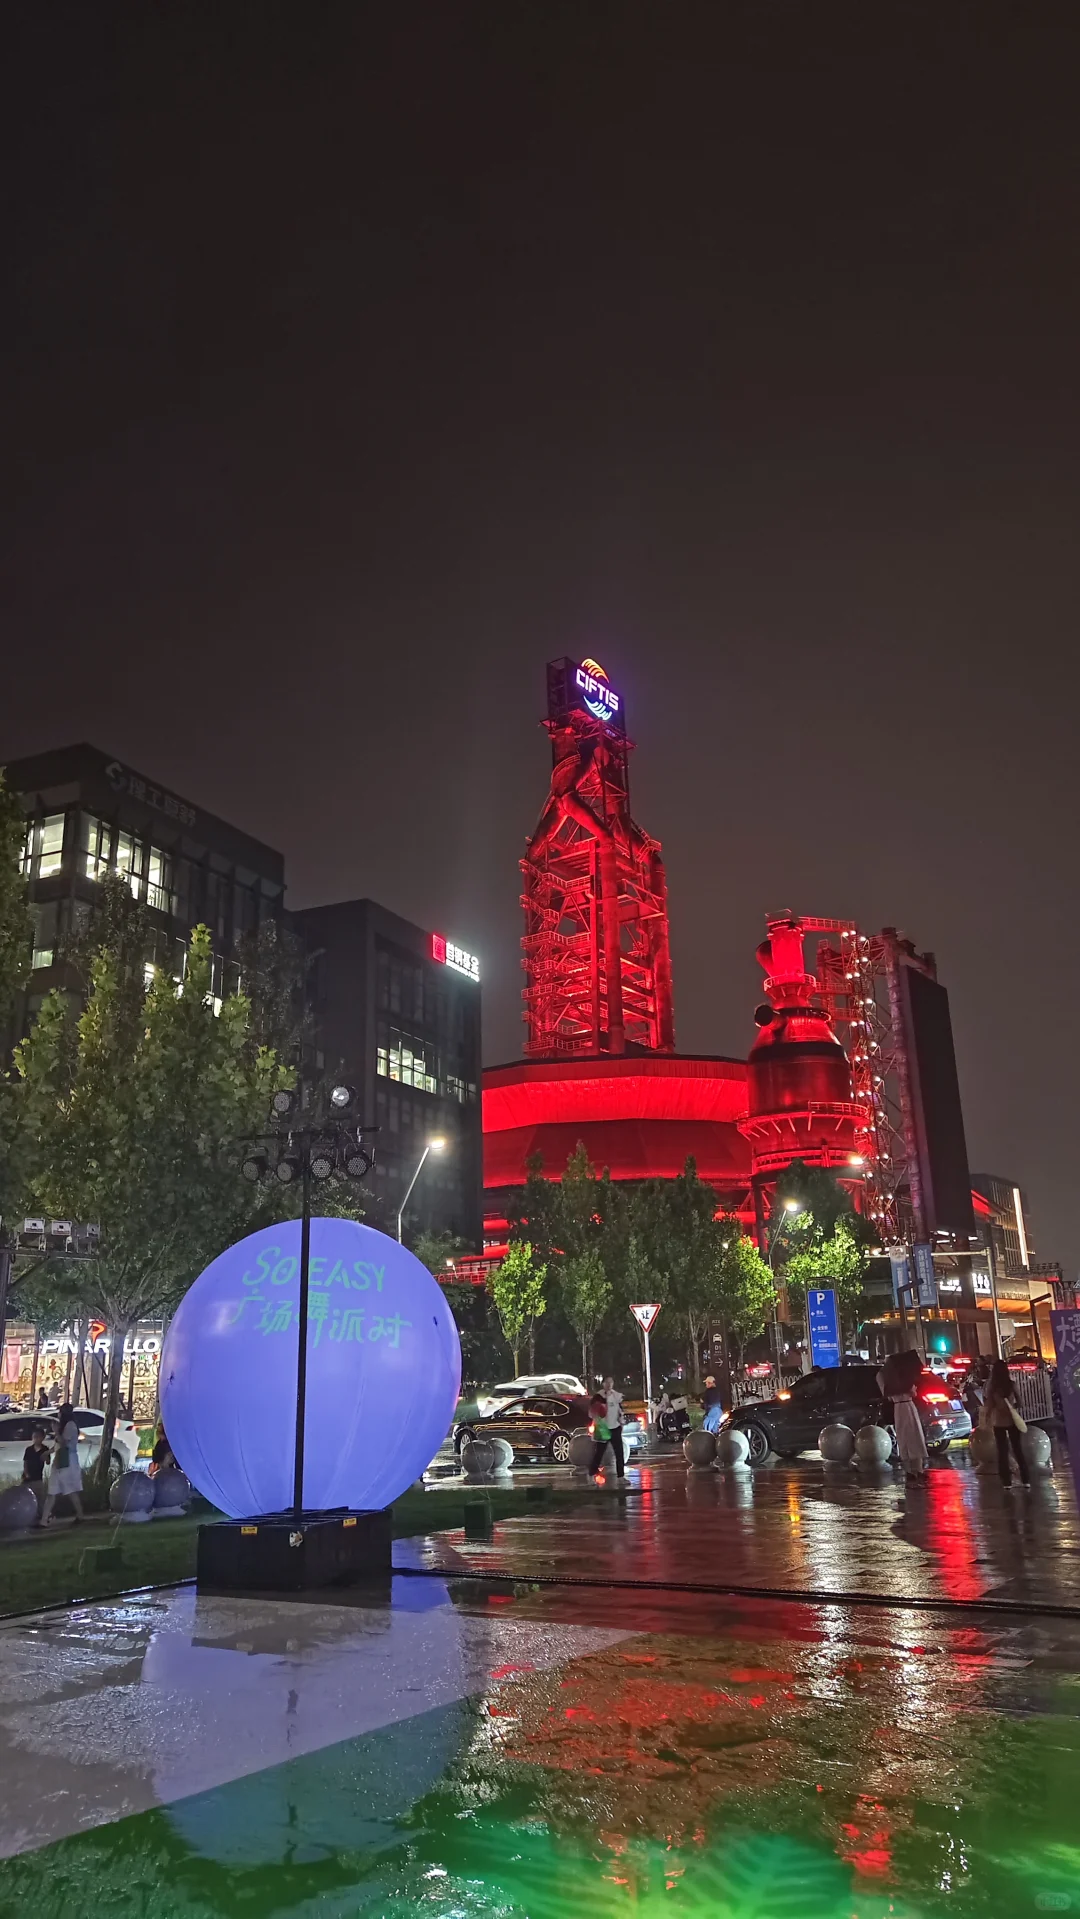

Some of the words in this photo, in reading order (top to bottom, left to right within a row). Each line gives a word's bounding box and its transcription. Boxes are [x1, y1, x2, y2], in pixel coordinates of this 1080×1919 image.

[576, 669, 619, 711] CIFTIS
[242, 1246, 298, 1285] SO
[308, 1257, 385, 1292] EASY
[816, 1293, 826, 1305] P
[231, 1288, 412, 1348] 广场舞派对
[641, 1310, 650, 1319] 让
[41, 1338, 160, 1355] PINARLLO
